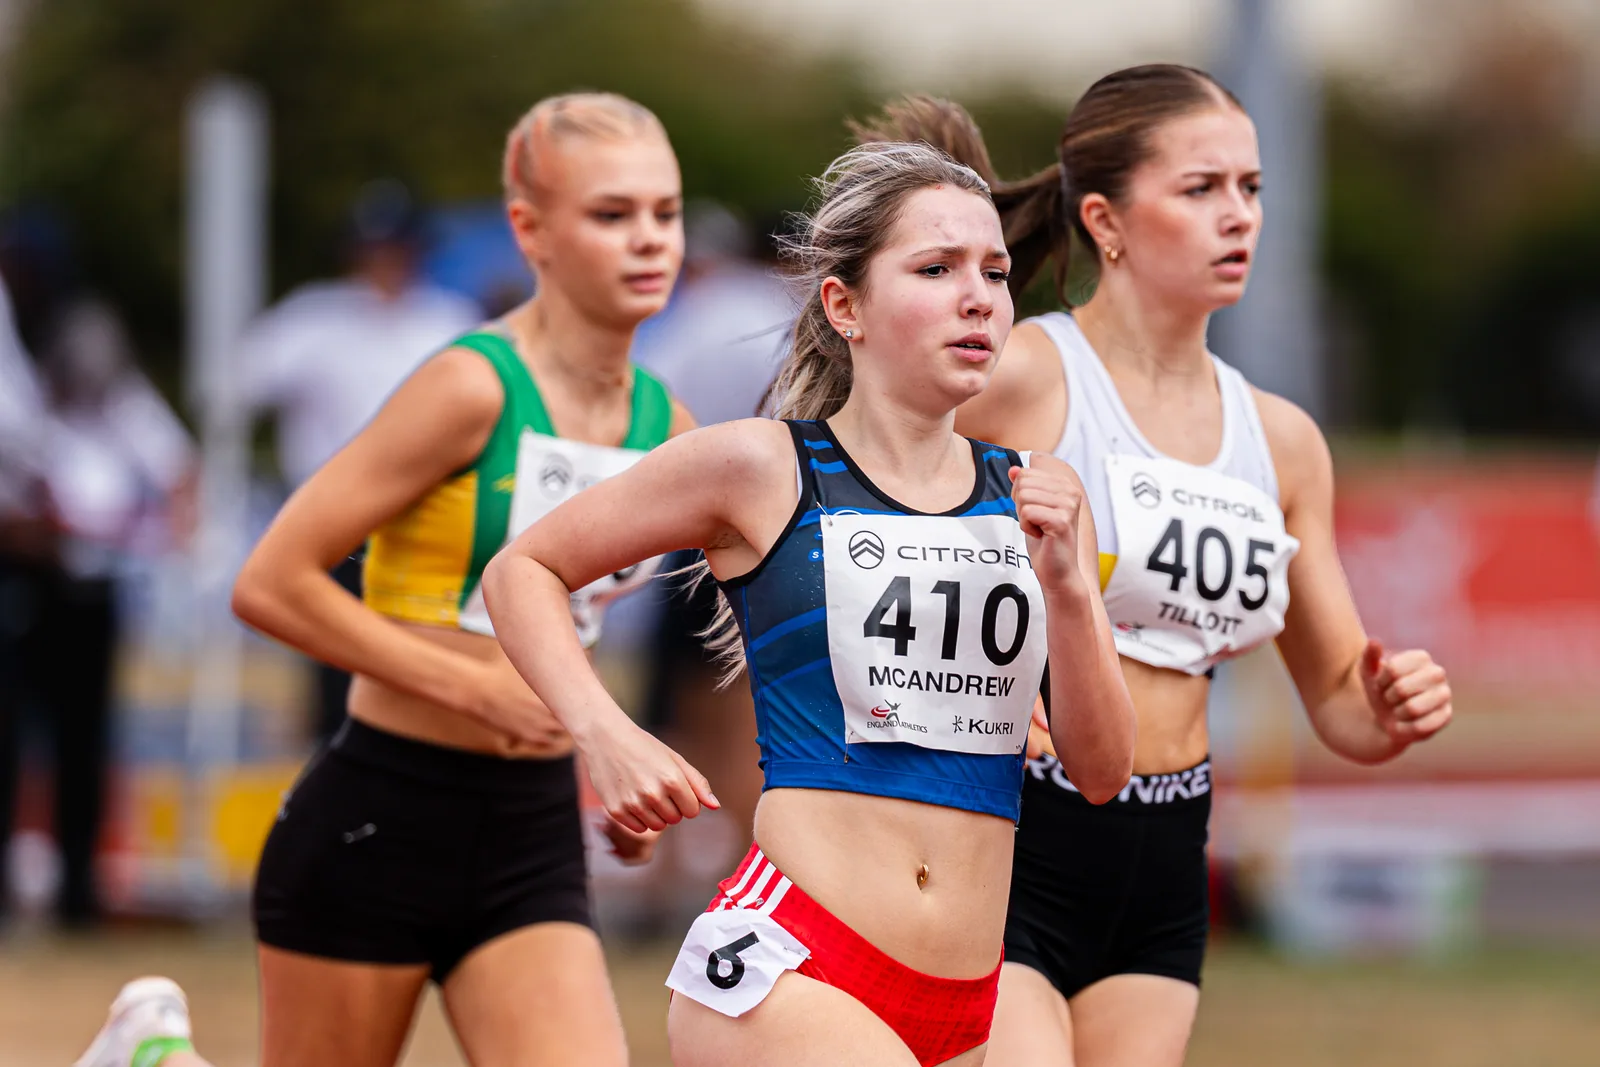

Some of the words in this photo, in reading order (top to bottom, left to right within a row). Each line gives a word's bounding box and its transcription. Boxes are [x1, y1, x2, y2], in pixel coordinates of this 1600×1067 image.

[1146, 517, 1275, 611] 405
[863, 576, 1030, 666] 410
[1158, 602, 1242, 635] TILLOTT
[868, 666, 1016, 697] MCANDREW
[867, 720, 898, 729] ENGLAND
[900, 721, 928, 733] ATHLETICS
[968, 719, 1014, 735] KUKRI
[1118, 763, 1211, 804] NIKE
[706, 931, 760, 990] 6
